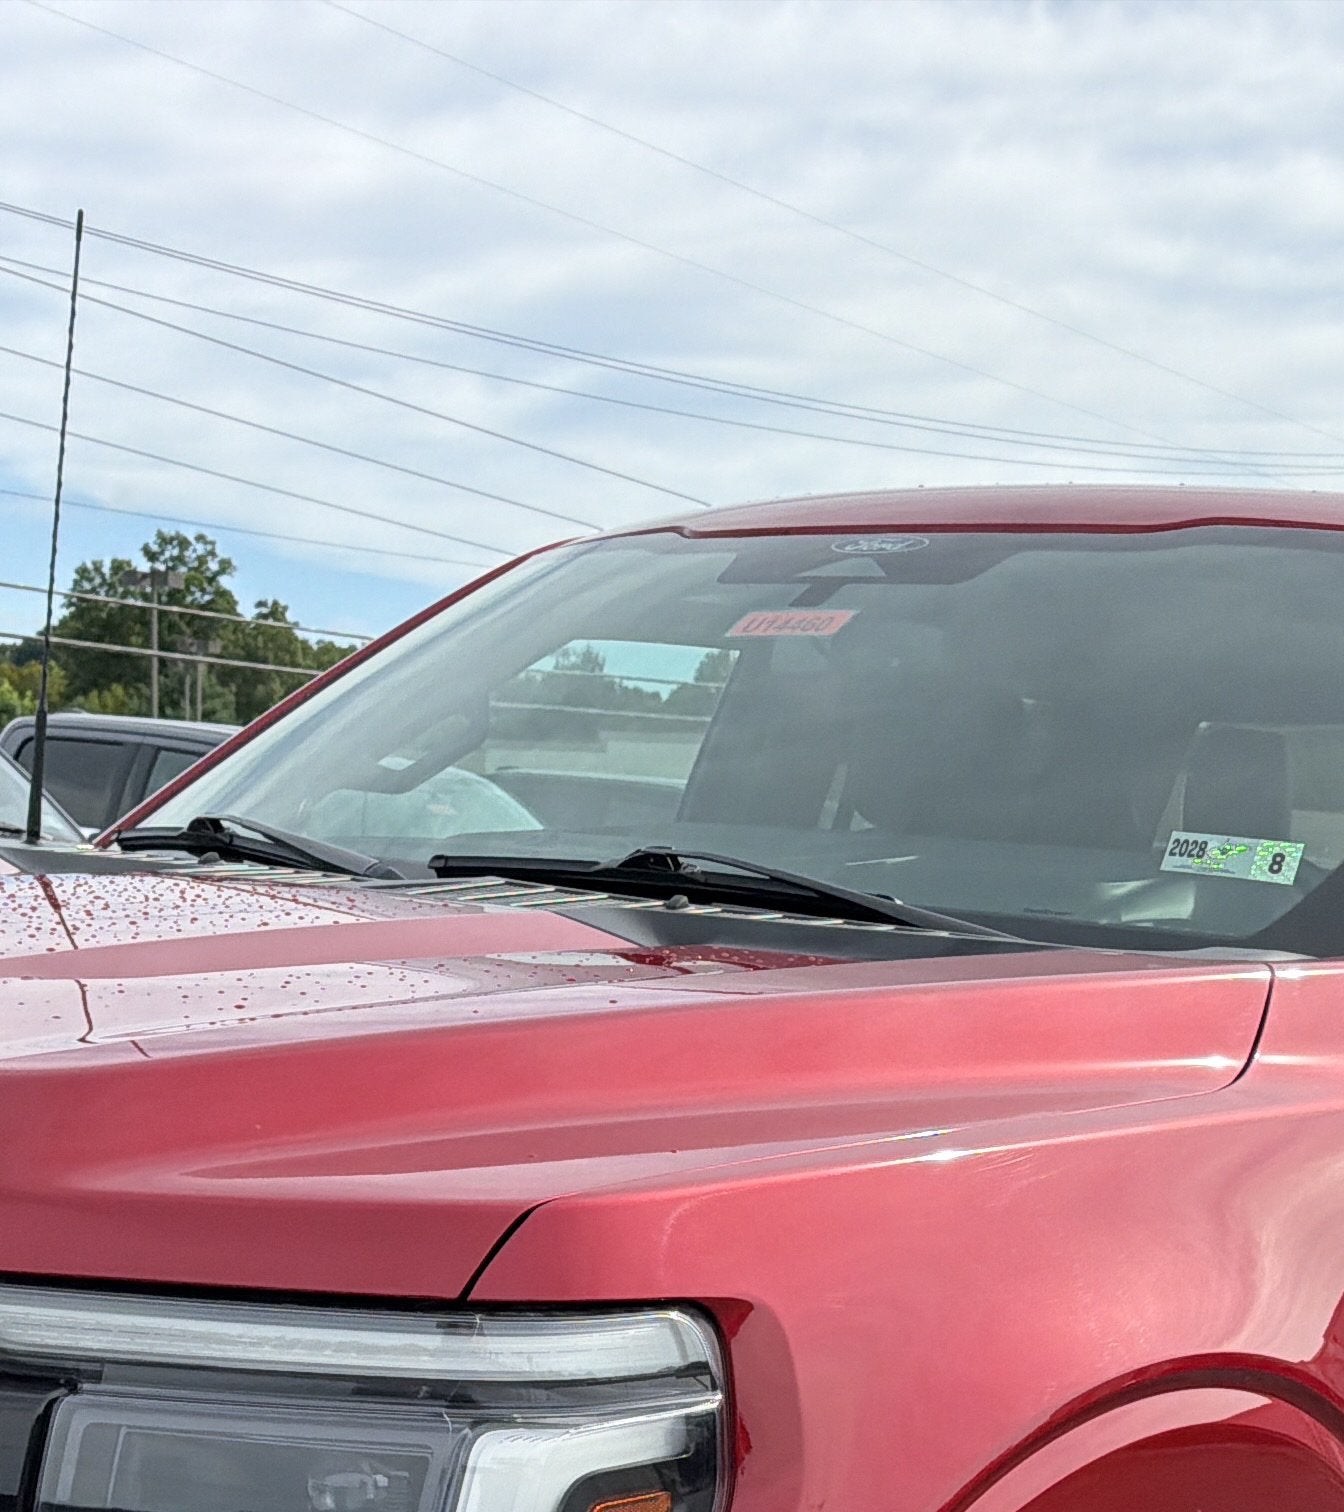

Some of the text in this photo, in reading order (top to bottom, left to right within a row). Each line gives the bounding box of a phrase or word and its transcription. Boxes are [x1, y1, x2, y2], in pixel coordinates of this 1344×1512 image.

[844, 537, 914, 552] Ford
[742, 615, 835, 634] U14460
[1168, 837, 1209, 860] 2028
[1267, 852, 1286, 875] 8
